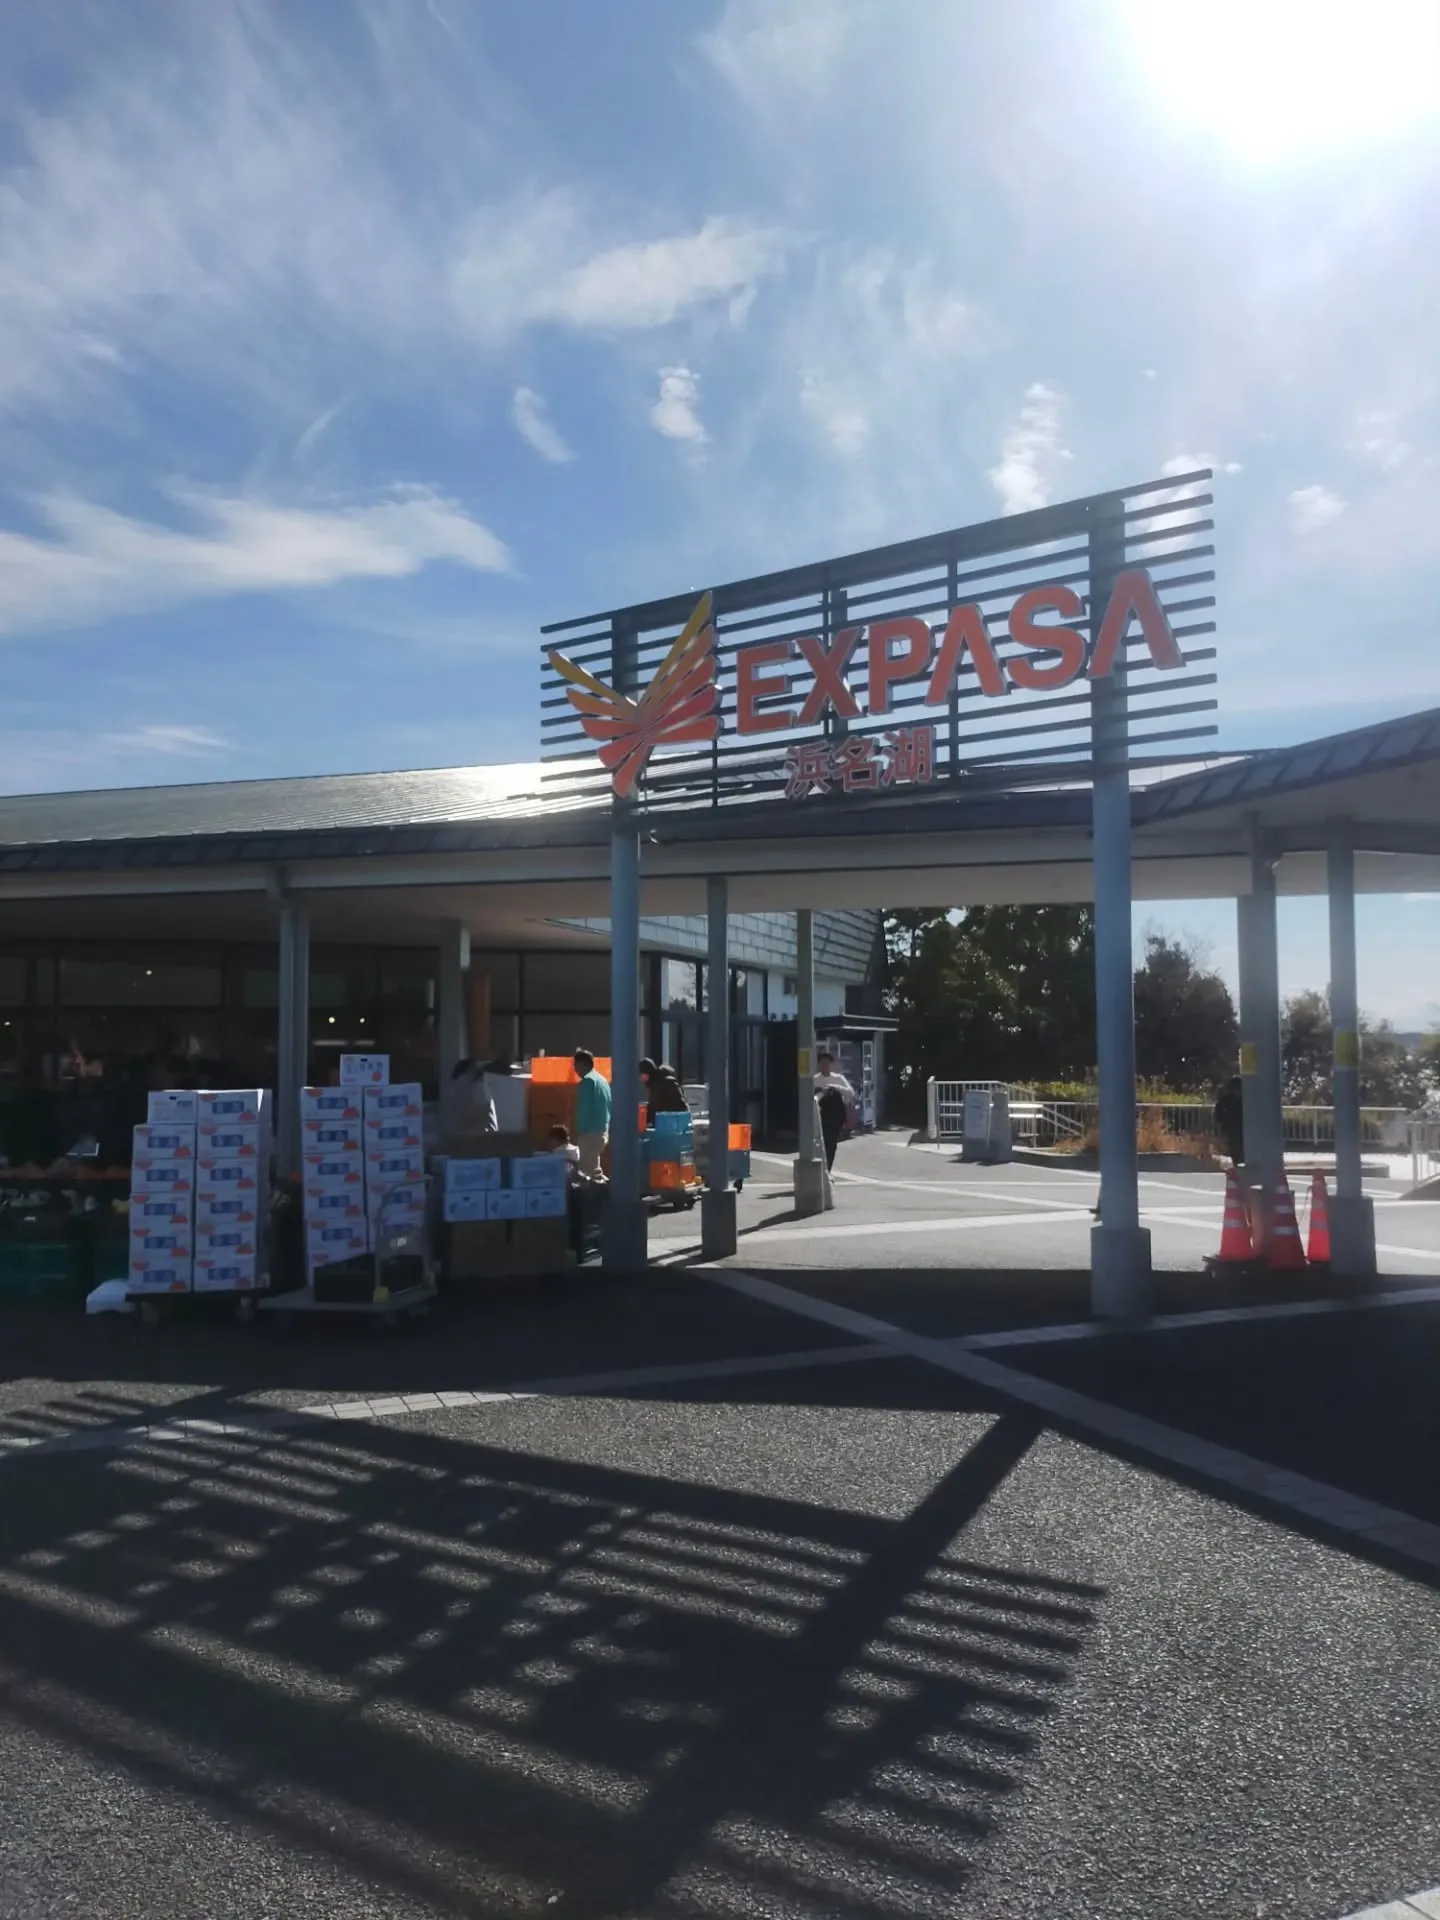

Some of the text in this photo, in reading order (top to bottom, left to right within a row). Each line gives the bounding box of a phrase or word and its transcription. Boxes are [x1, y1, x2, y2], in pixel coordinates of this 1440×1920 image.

[736, 567, 1186, 737] EXPASA
[784, 726, 935, 799] 浜名湖
